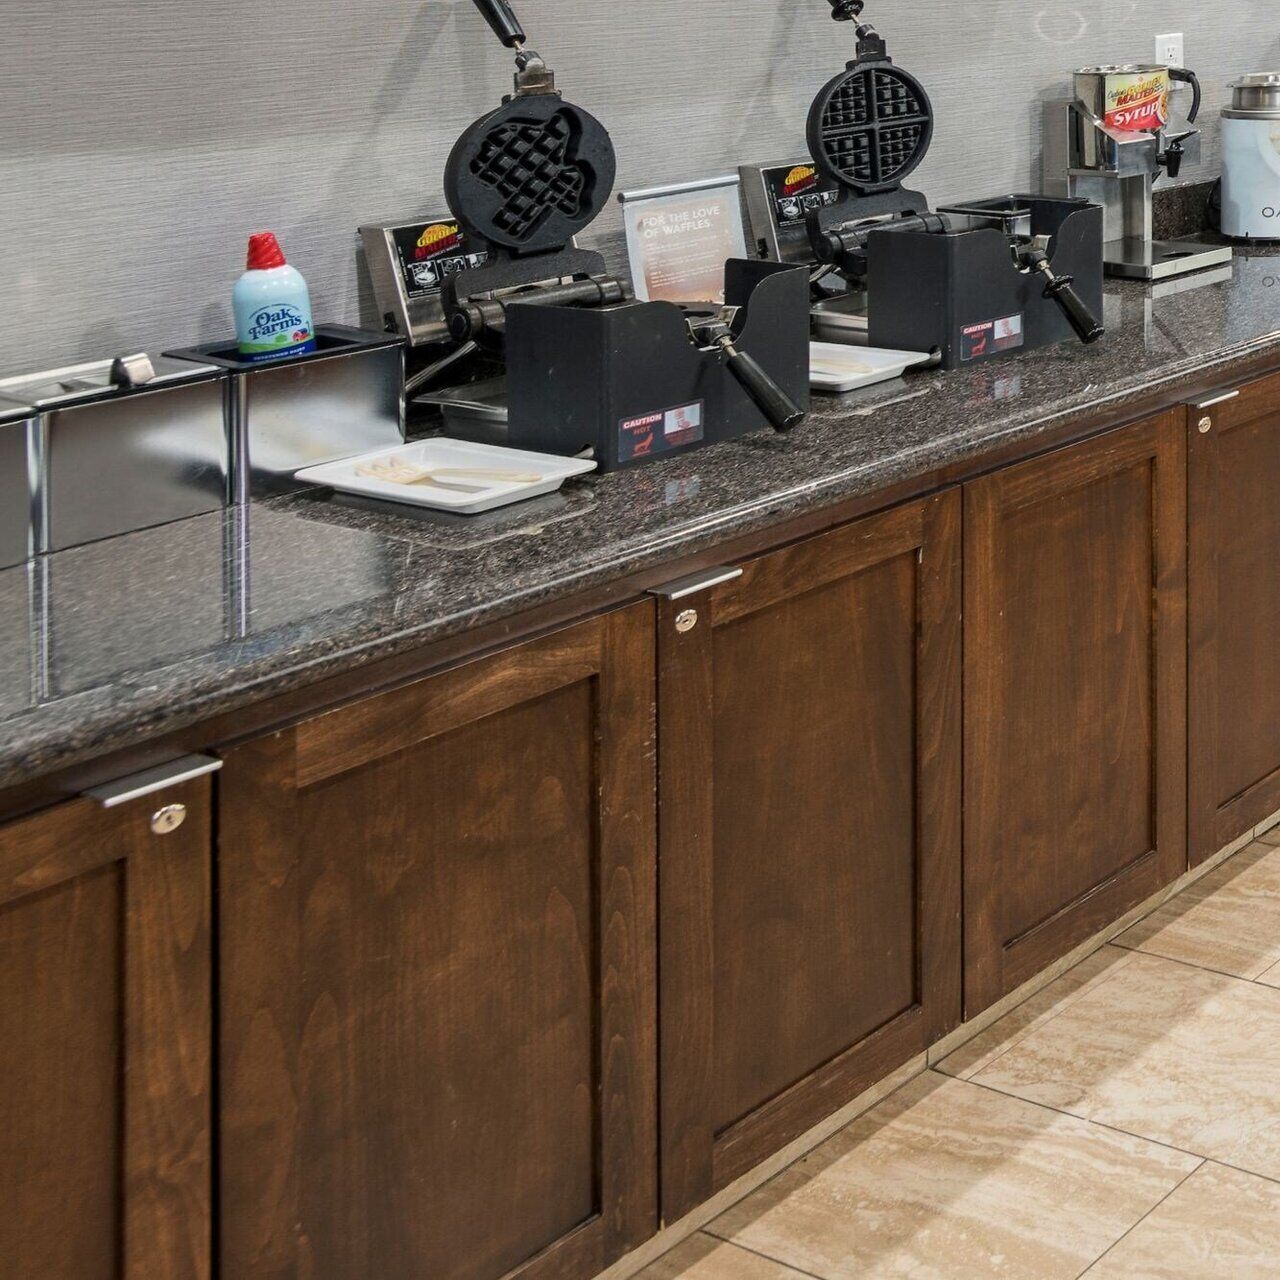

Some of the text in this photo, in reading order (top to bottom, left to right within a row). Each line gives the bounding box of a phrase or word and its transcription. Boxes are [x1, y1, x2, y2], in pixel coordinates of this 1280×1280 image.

[1114, 101, 1159, 125] Syrup
[643, 205, 721, 227] FOR THE LOVE
[644, 227, 660, 239] OF
[256, 308, 295, 326] Oak
[249, 315, 302, 340] Farms
[623, 413, 663, 430] CAUTION
